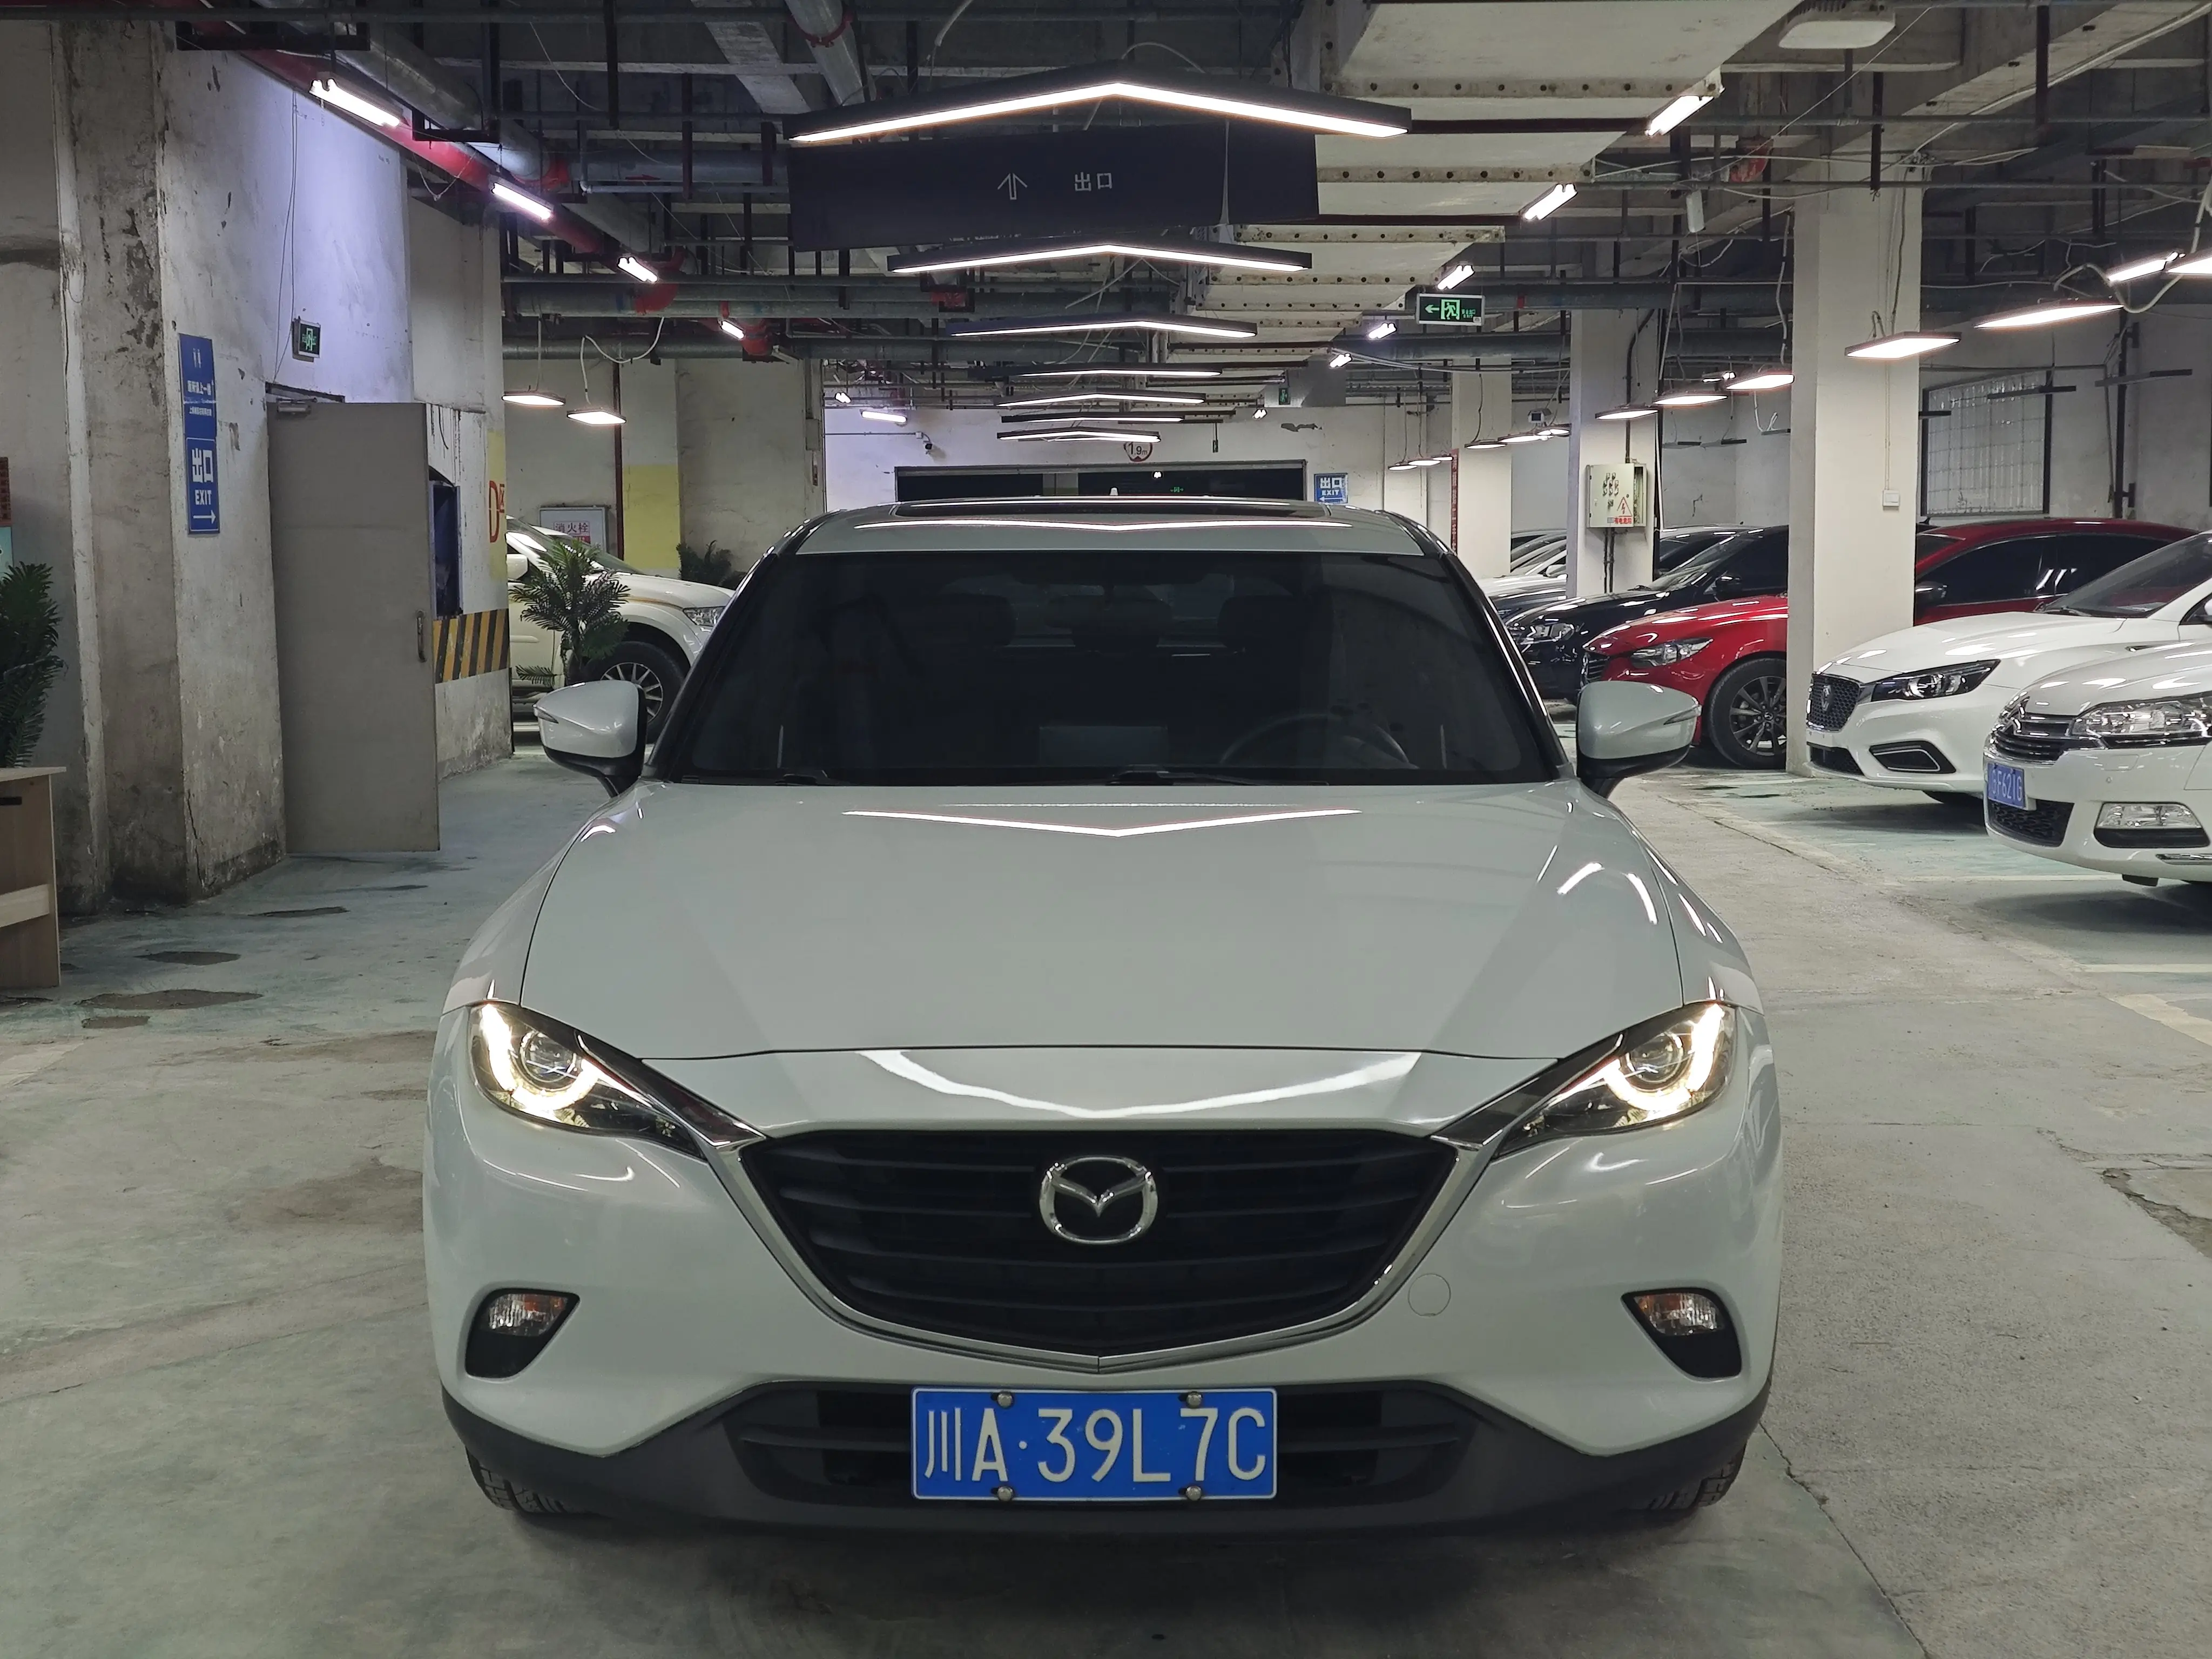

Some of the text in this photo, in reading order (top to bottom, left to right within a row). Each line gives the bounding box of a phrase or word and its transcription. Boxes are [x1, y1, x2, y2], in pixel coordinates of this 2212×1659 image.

[1075, 172, 1112, 191] 出口
[192, 448, 213, 483] 出口
[1320, 477, 1343, 489] 出口
[194, 489, 212, 505] EXIT
[555, 522, 588, 533] 消火栓
[924, 1407, 1266, 1482] 川A·39L7C
